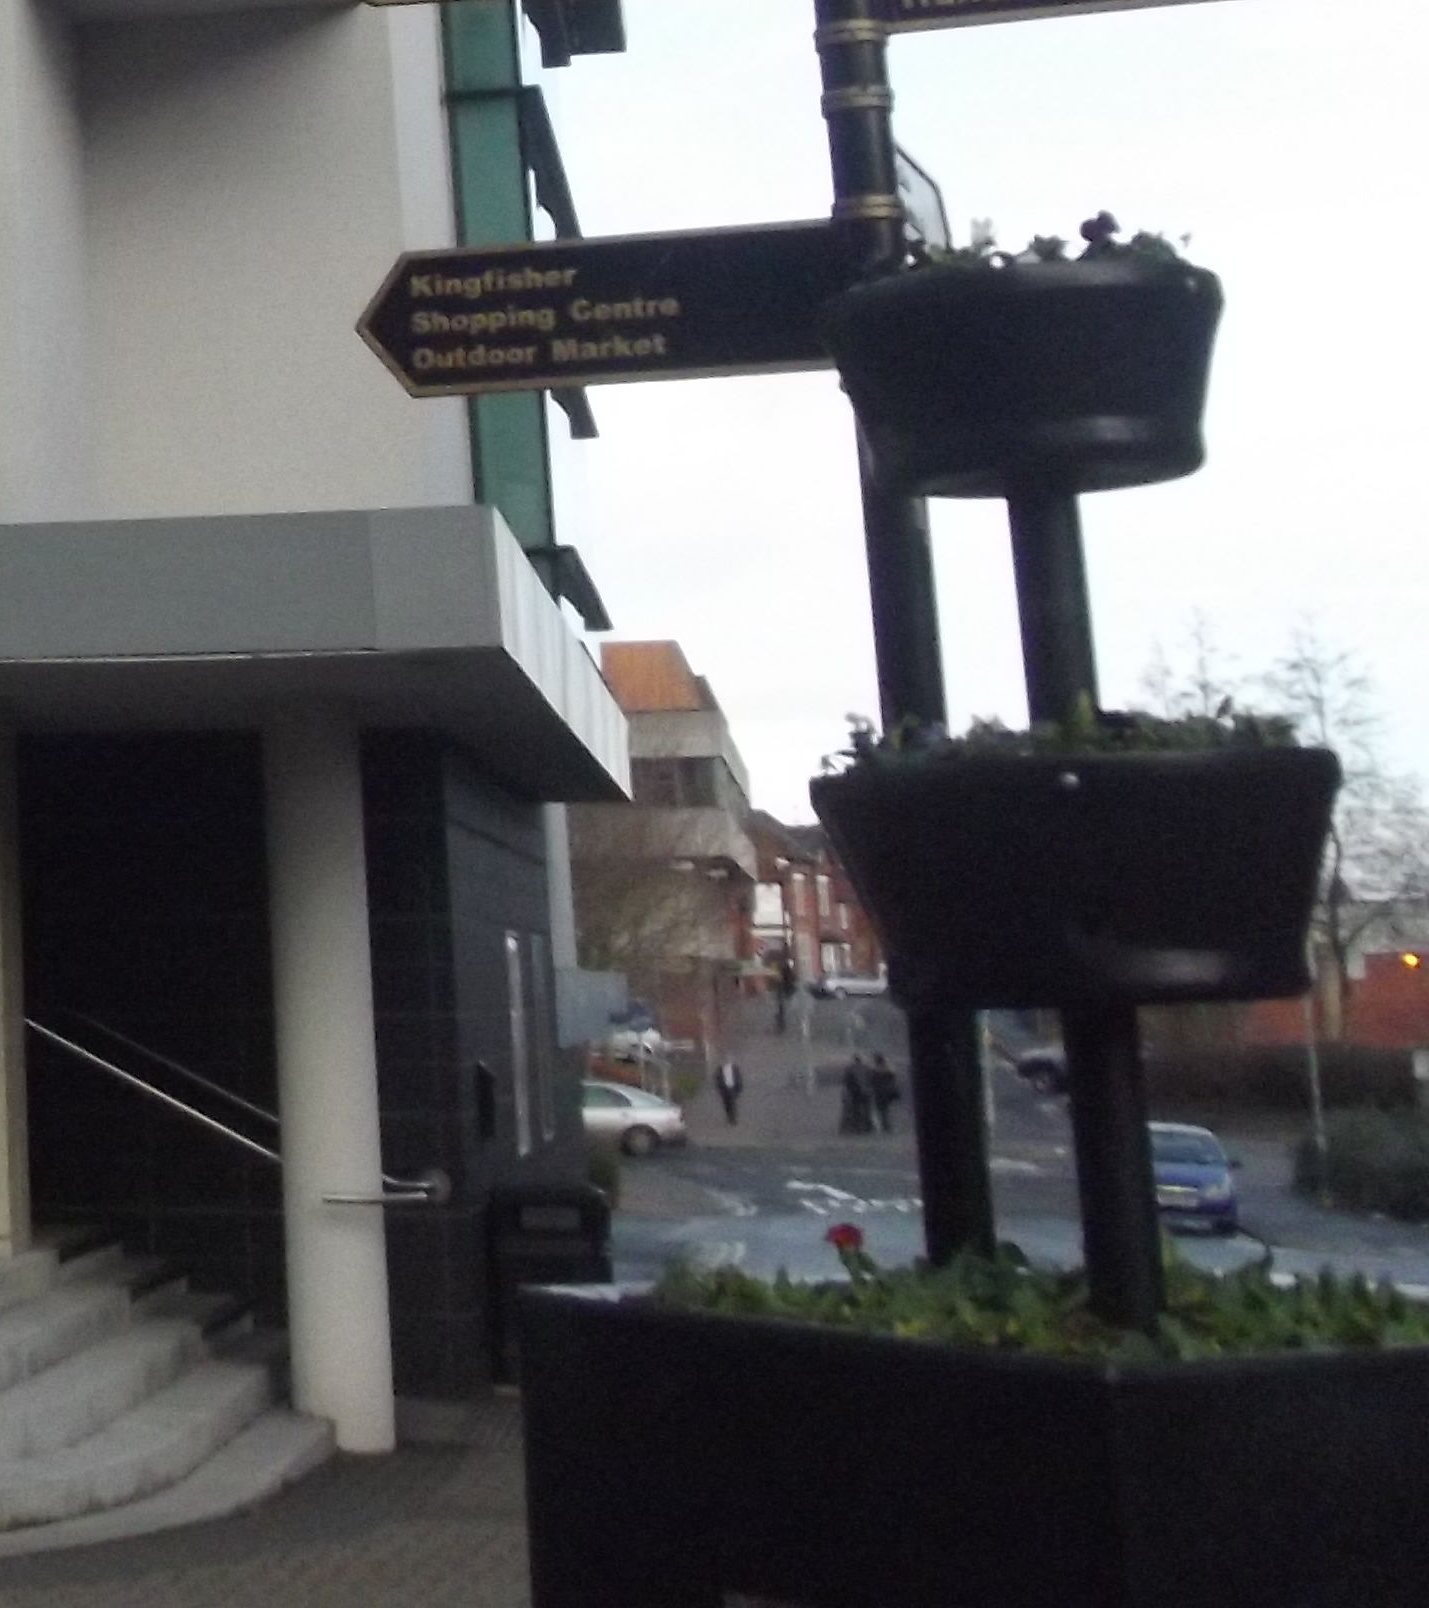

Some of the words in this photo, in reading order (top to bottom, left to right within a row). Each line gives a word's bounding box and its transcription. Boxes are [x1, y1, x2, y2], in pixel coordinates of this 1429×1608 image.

[409, 266, 578, 299] Kingfisher
[411, 306, 558, 335] Shopping
[568, 296, 681, 322] Centre
[412, 344, 538, 370] Outdoor
[550, 334, 667, 362] Market
